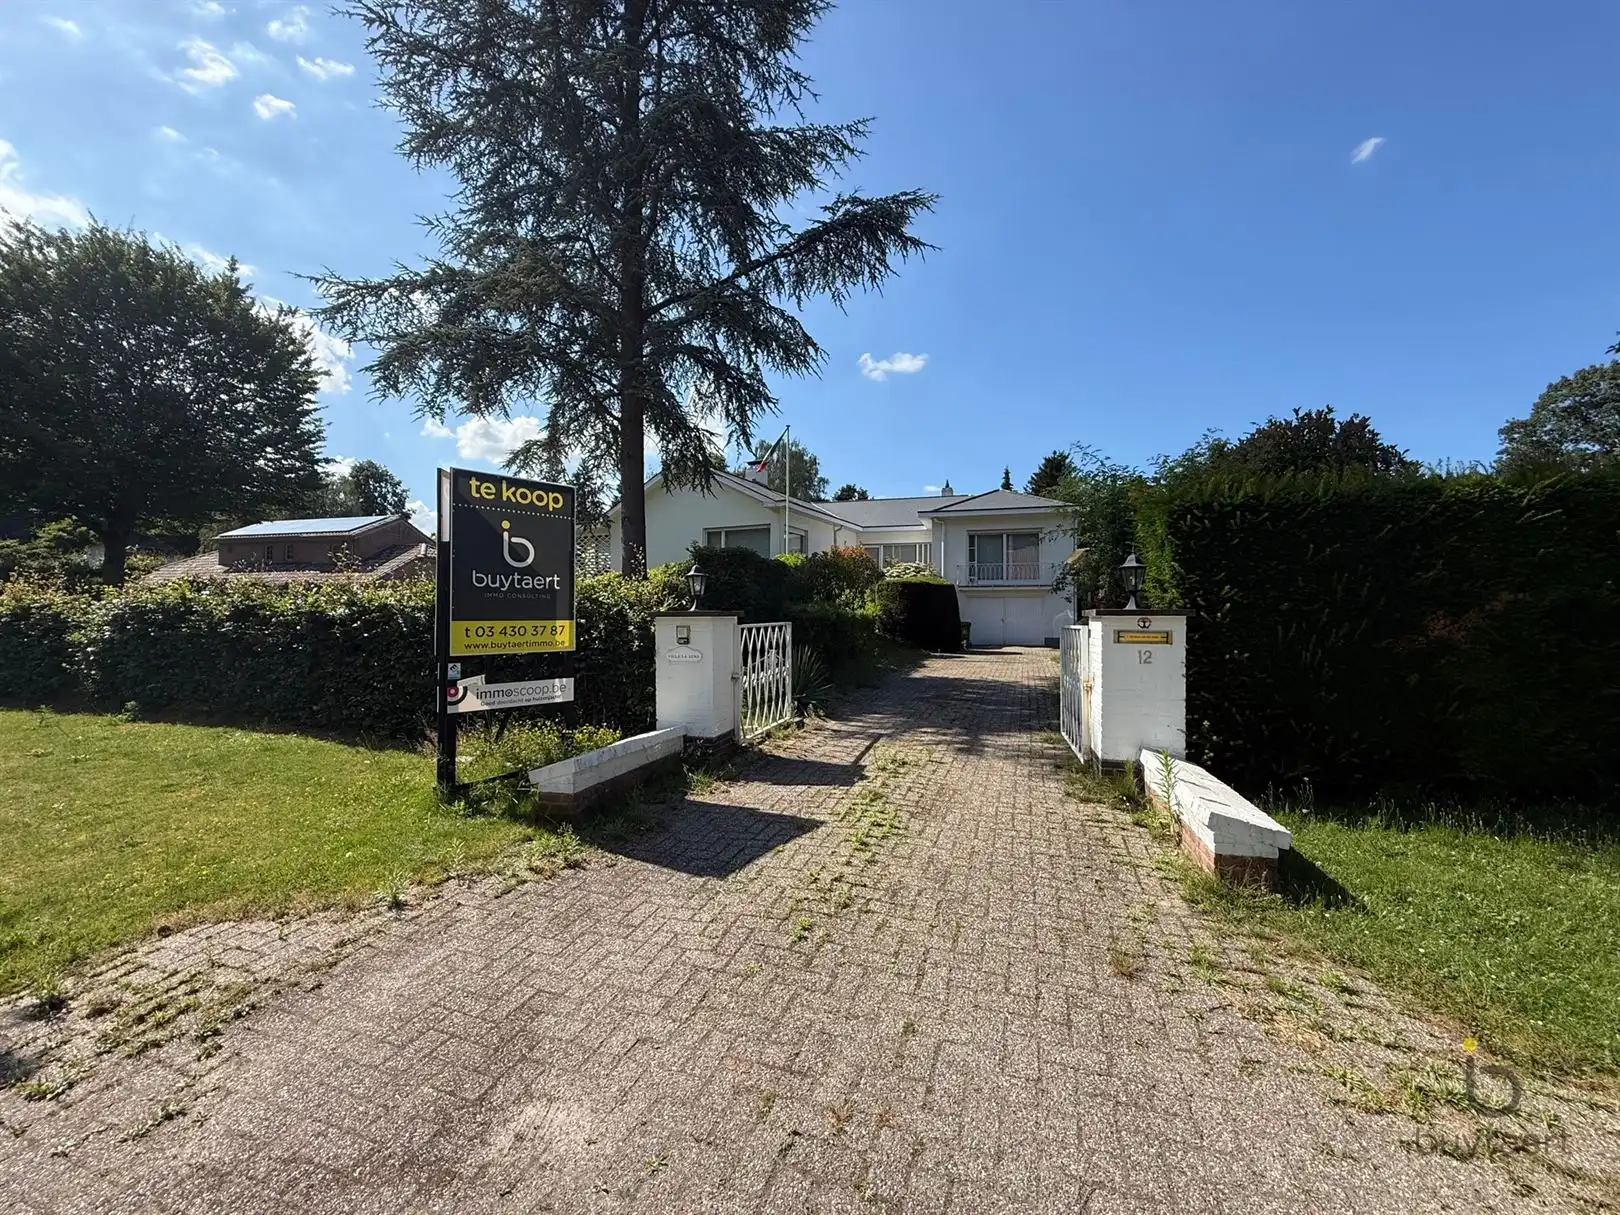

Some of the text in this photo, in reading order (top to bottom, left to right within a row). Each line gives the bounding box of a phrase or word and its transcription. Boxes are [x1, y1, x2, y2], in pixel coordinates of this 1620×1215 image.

[469, 477, 564, 512] te koop
[472, 570, 560, 591] buytaert
[464, 625, 565, 638] t 03 430 37 87
[464, 639, 565, 650] www.buytaertimmo.be
[1138, 649, 1152, 665] 12
[476, 683, 567, 700] immoscoop.be
